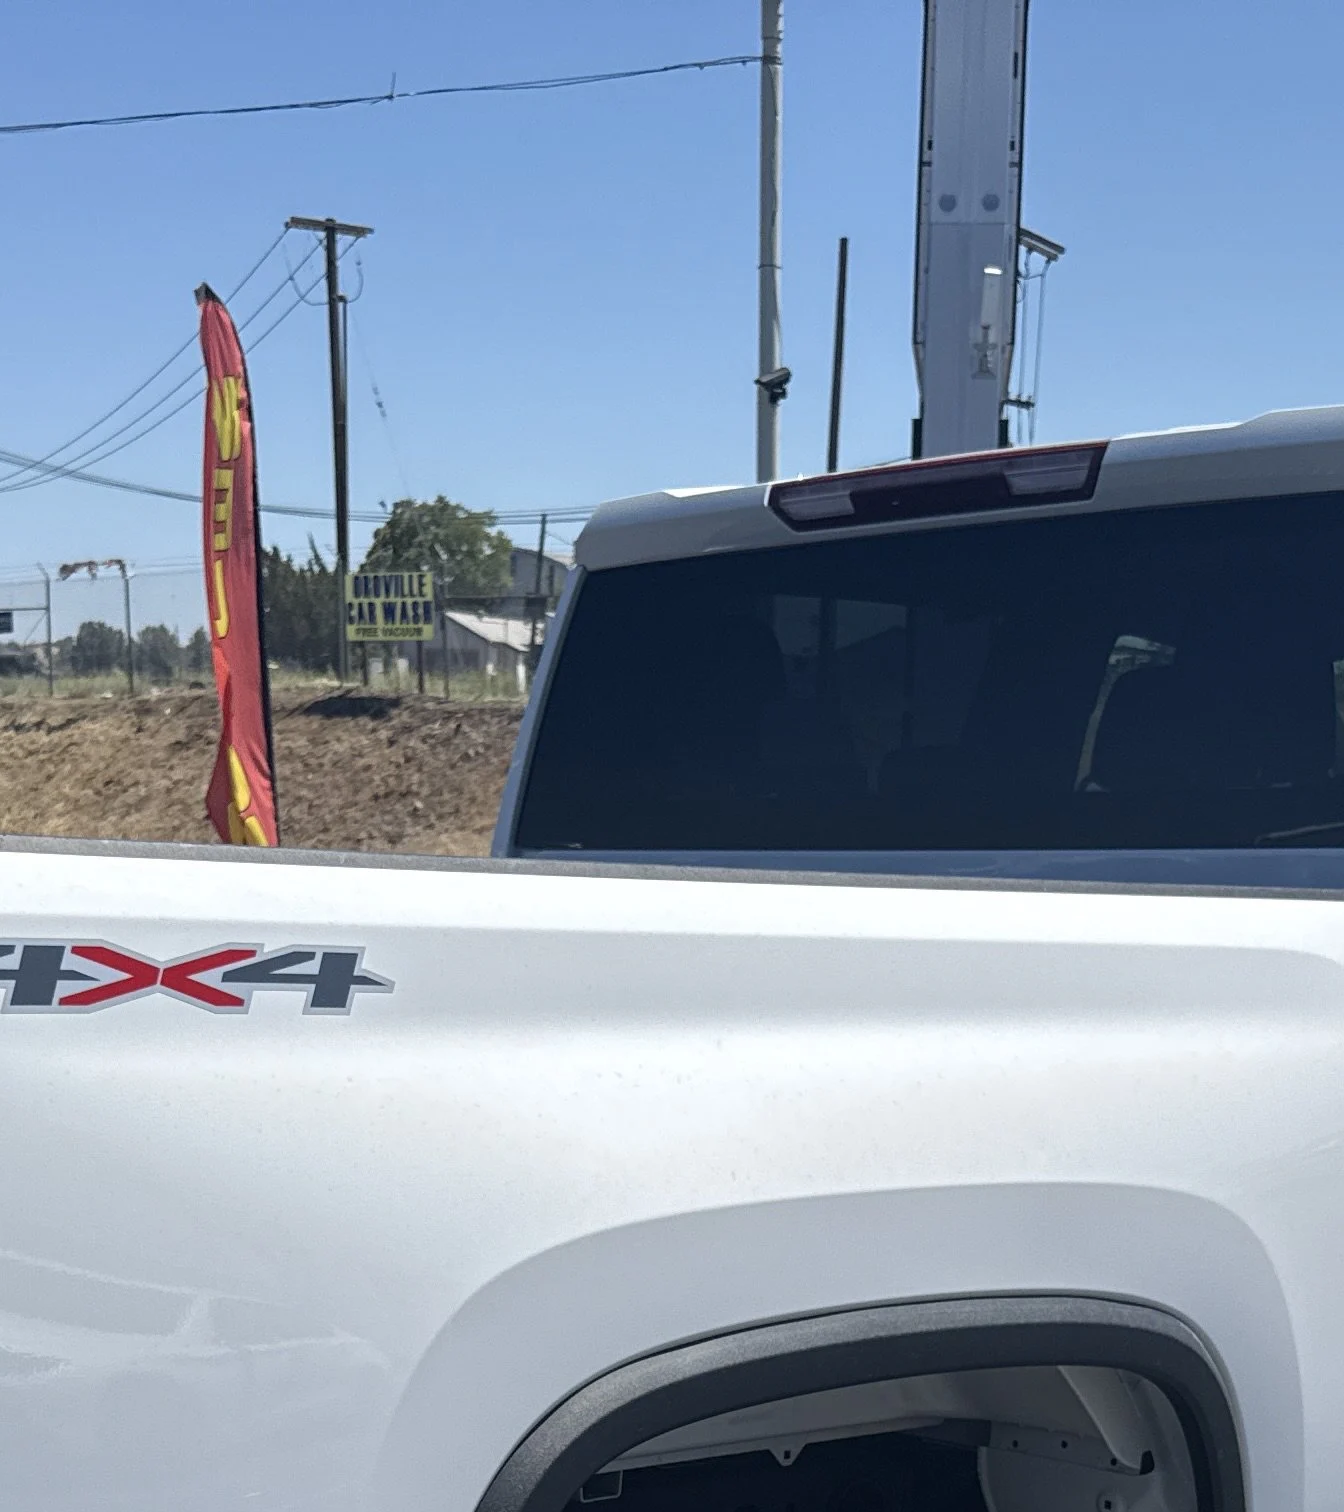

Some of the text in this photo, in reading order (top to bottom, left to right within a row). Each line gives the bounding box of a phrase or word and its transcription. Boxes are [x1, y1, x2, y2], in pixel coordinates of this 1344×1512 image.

[353, 574, 426, 598] OROVILLE
[347, 600, 433, 625] CAR WASH
[355, 627, 379, 637] FREE
